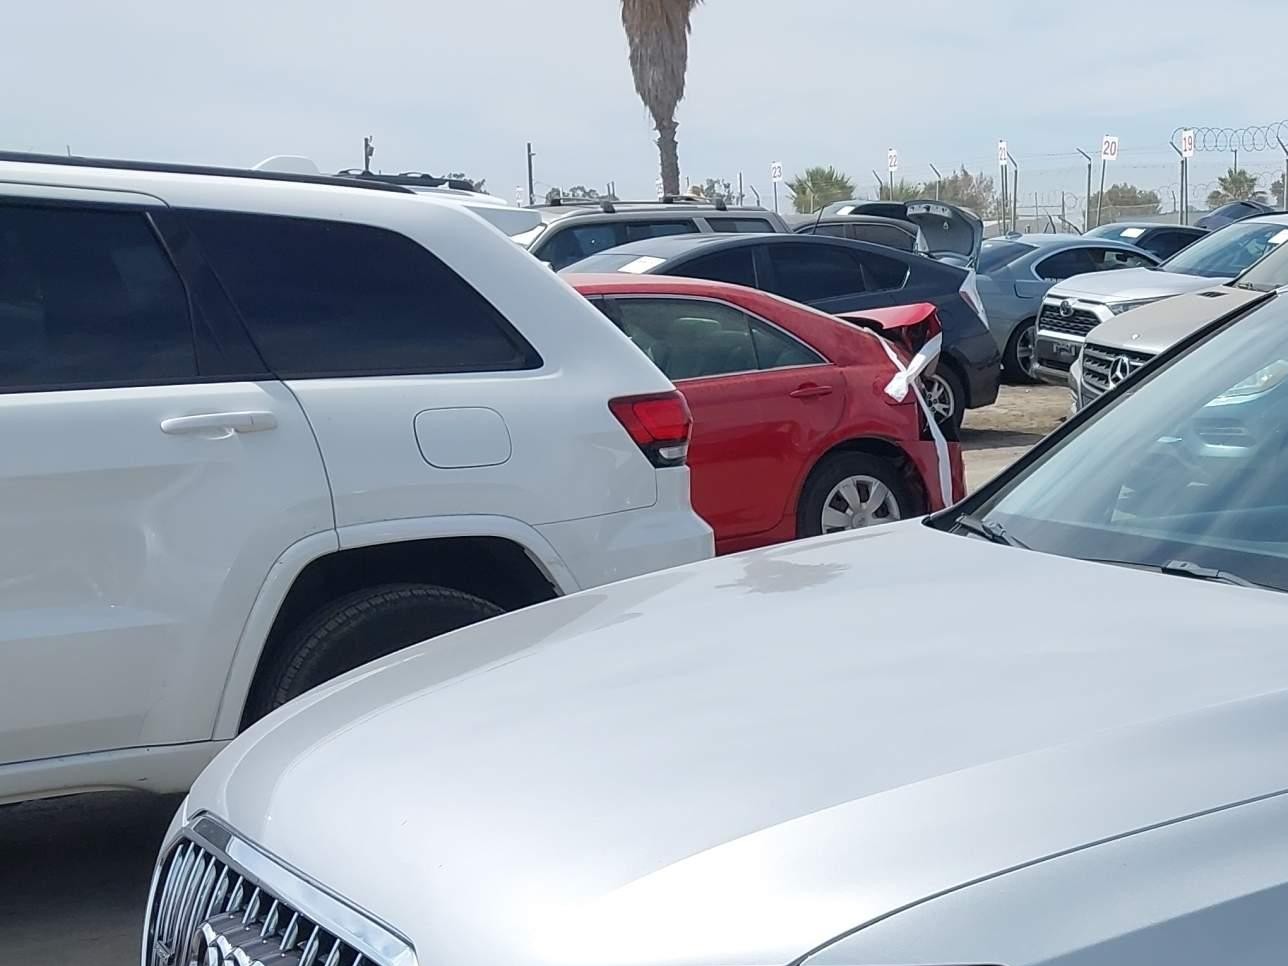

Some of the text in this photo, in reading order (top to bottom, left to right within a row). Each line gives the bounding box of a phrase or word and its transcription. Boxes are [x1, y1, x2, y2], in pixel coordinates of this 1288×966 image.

[1102, 141, 1117, 156] 20
[1183, 137, 1193, 152] 19
[888, 154, 897, 167] 22
[999, 147, 1007, 161] 21
[772, 166, 782, 178] 23
